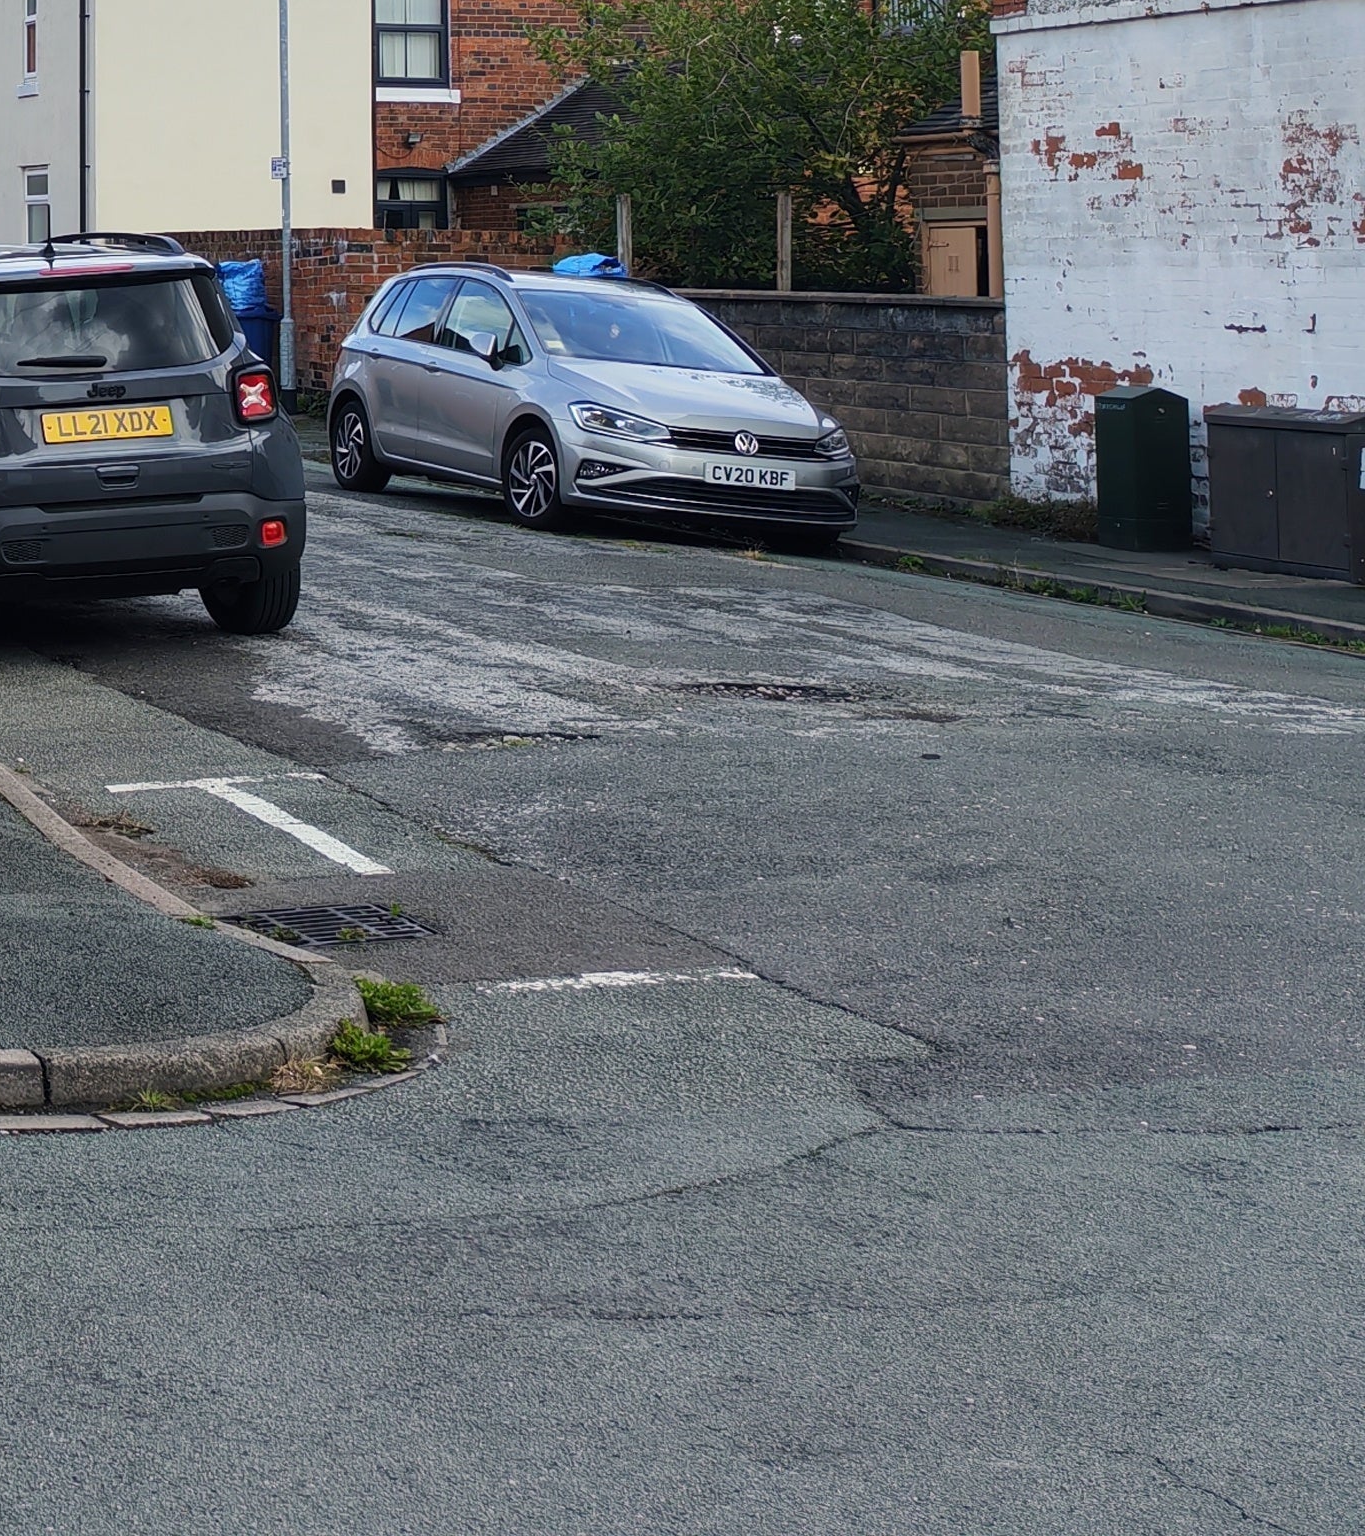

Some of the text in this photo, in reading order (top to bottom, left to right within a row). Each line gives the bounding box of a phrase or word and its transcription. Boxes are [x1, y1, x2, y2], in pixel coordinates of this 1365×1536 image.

[87, 383, 127, 399] Jeep
[57, 410, 158, 437] LL21 XDX
[712, 466, 789, 486] CV20 KBF
